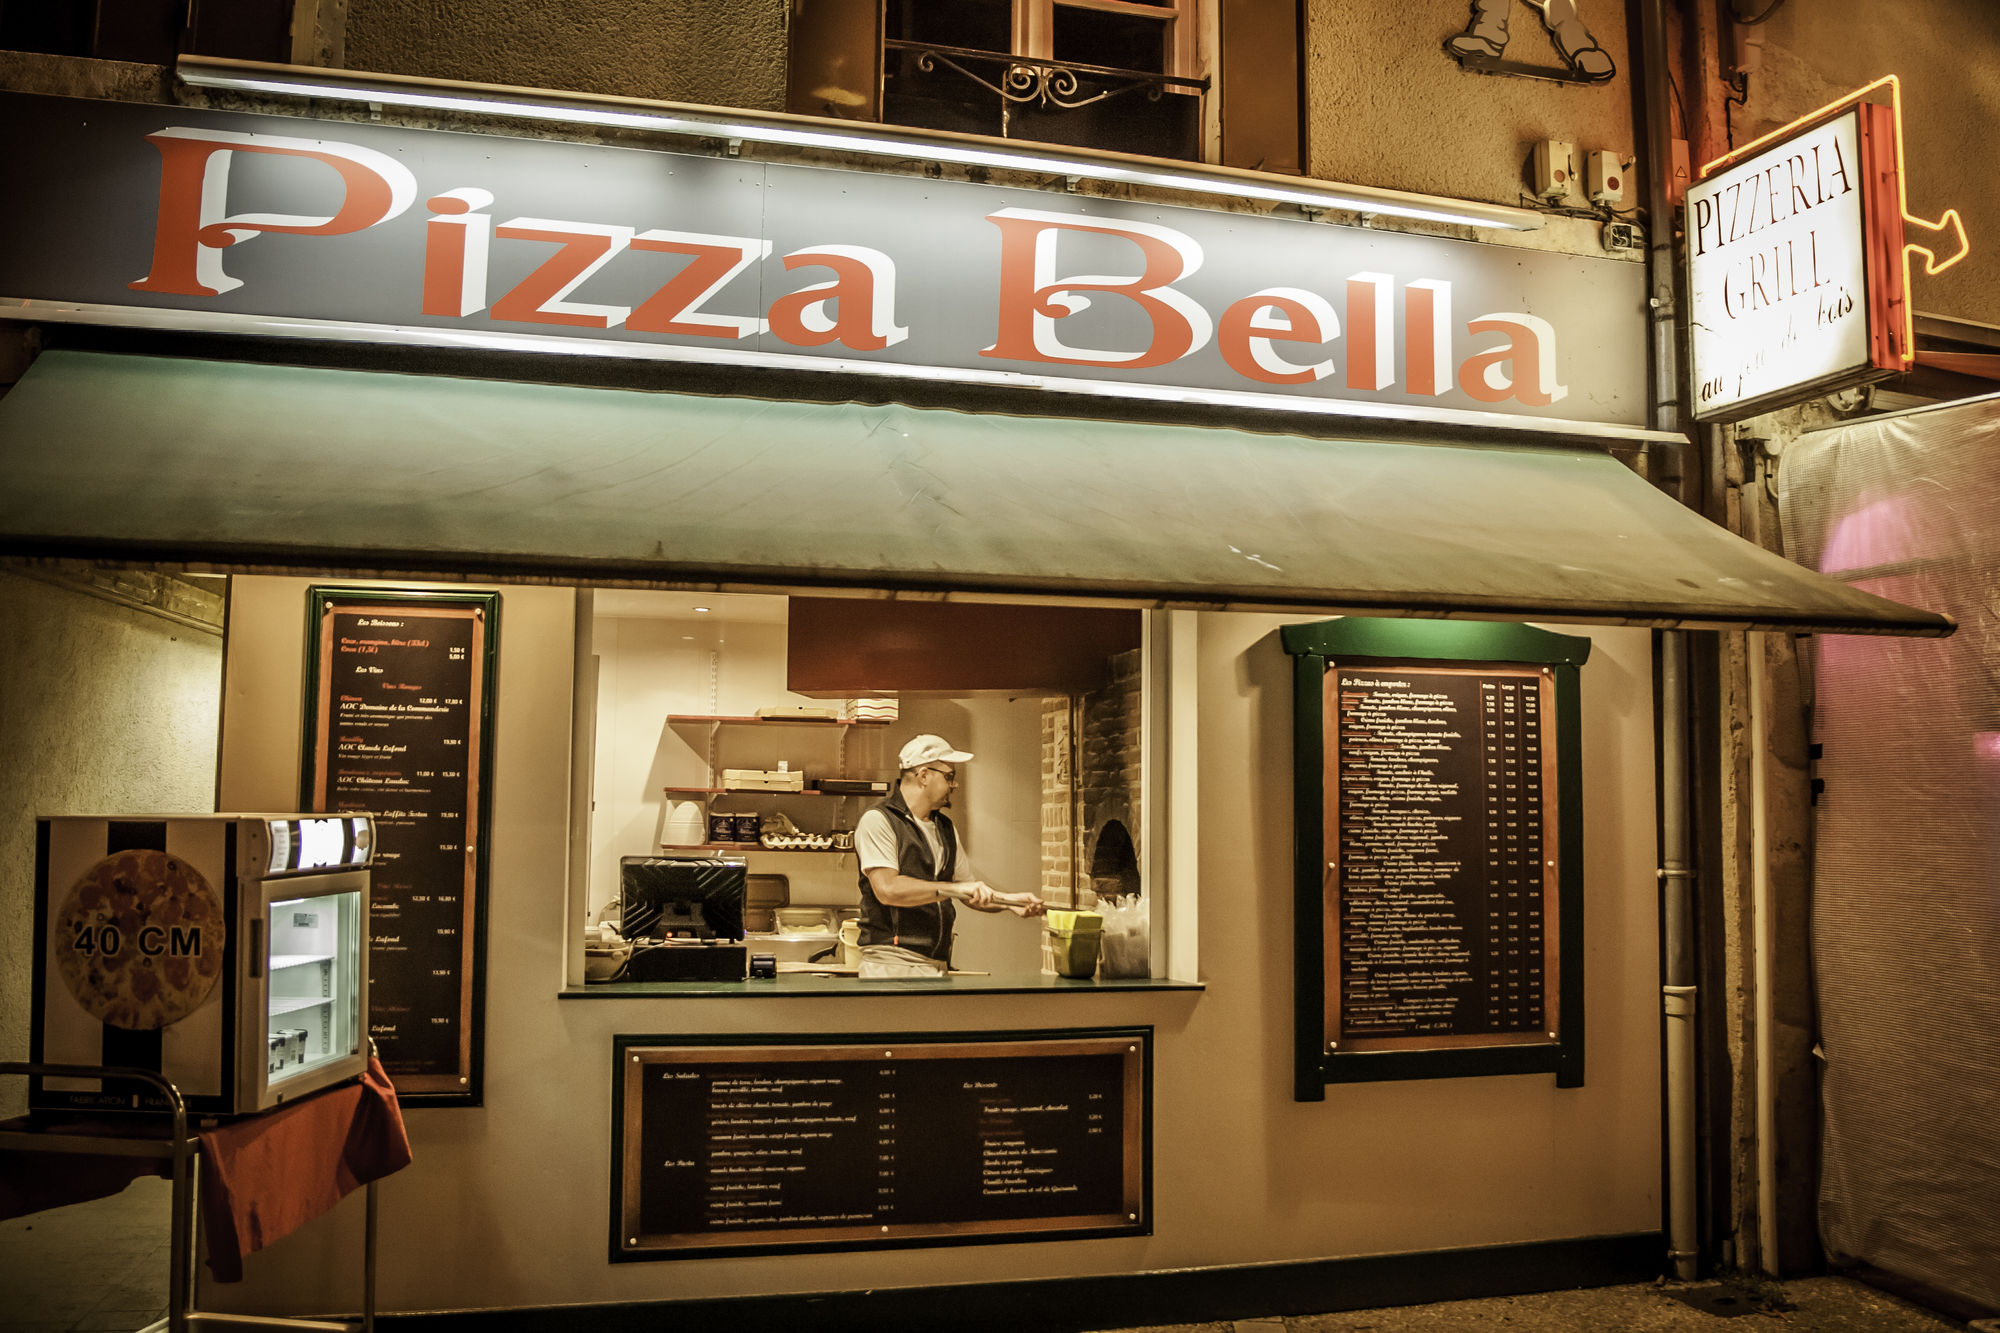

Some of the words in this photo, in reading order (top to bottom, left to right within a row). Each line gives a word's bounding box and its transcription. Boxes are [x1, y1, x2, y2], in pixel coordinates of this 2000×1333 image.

[1694, 135, 1852, 256] PIZZERIA
[127, 126, 909, 351] Pizza
[978, 206, 1570, 406] Bella
[1724, 230, 1831, 319] GRILL
[1701, 375, 1723, 402] au
[1817, 285, 1854, 330] bois
[74, 926, 121, 956] 40
[138, 926, 201, 956] CM
